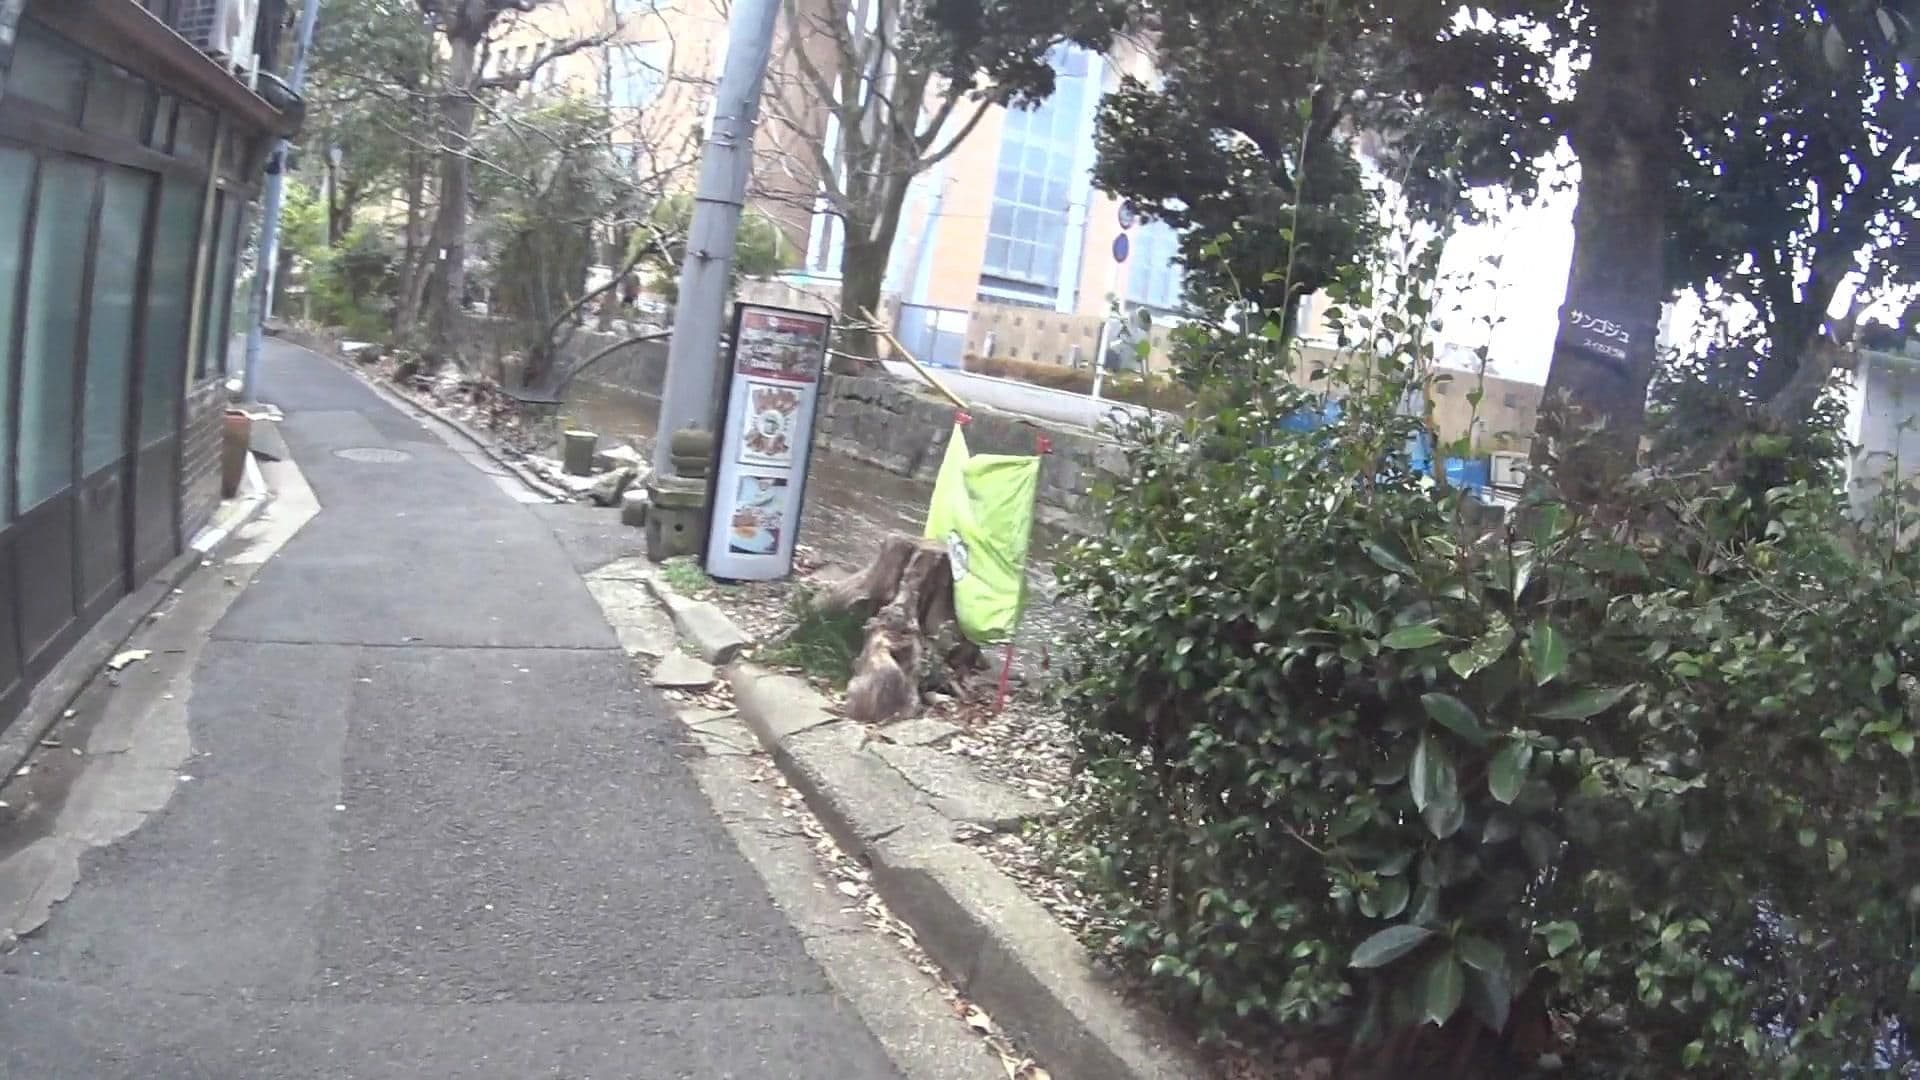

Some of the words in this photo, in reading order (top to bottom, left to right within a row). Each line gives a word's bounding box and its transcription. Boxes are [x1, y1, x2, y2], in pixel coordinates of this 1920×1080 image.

[1569, 309, 1630, 344] サンゴジュ
